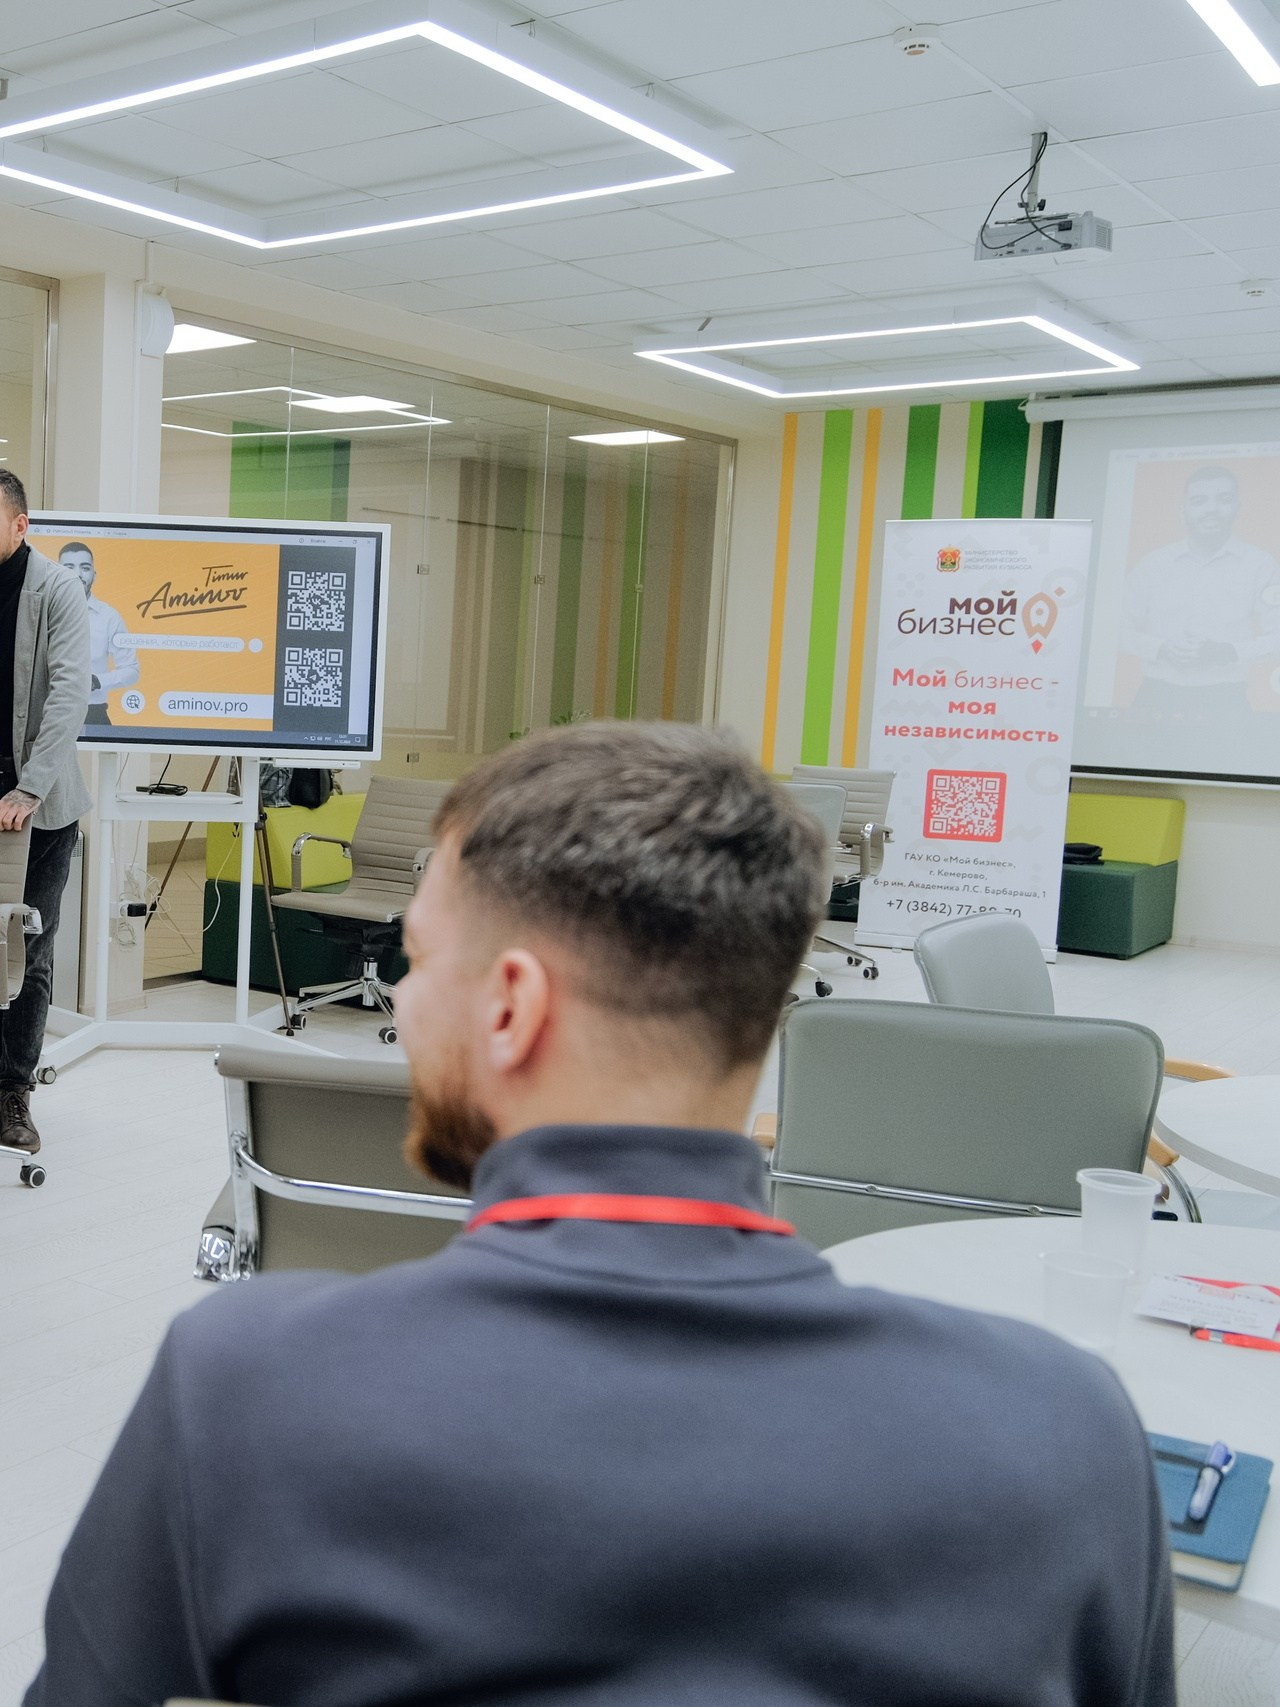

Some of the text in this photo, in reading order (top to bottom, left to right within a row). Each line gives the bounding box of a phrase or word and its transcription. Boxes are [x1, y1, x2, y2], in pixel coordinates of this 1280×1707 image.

[202, 564, 248, 587] Timur
[136, 581, 247, 618] Aminov
[948, 590, 1018, 615] мой
[897, 608, 1016, 636] бизнес
[162, 639, 197, 647] которые
[199, 638, 239, 649] работают
[892, 667, 947, 687] Мой
[954, 670, 1043, 690] бизнес
[168, 698, 248, 715] aminov.pro
[948, 701, 997, 715] моя
[884, 725, 1060, 743] независимость
[904, 852, 922, 861] ГАУ
[926, 854, 941, 862] КО
[943, 856, 971, 865] «Мой
[937, 869, 988, 881] Кемерово,
[873, 878, 889, 887] б-р
[891, 880, 906, 888] им.
[908, 880, 960, 892] Академика
[962, 884, 982, 893] Л.С.
[984, 886, 1040, 899] Барбараша,
[886, 899, 903, 910] +7
[906, 900, 953, 917] (3842)
